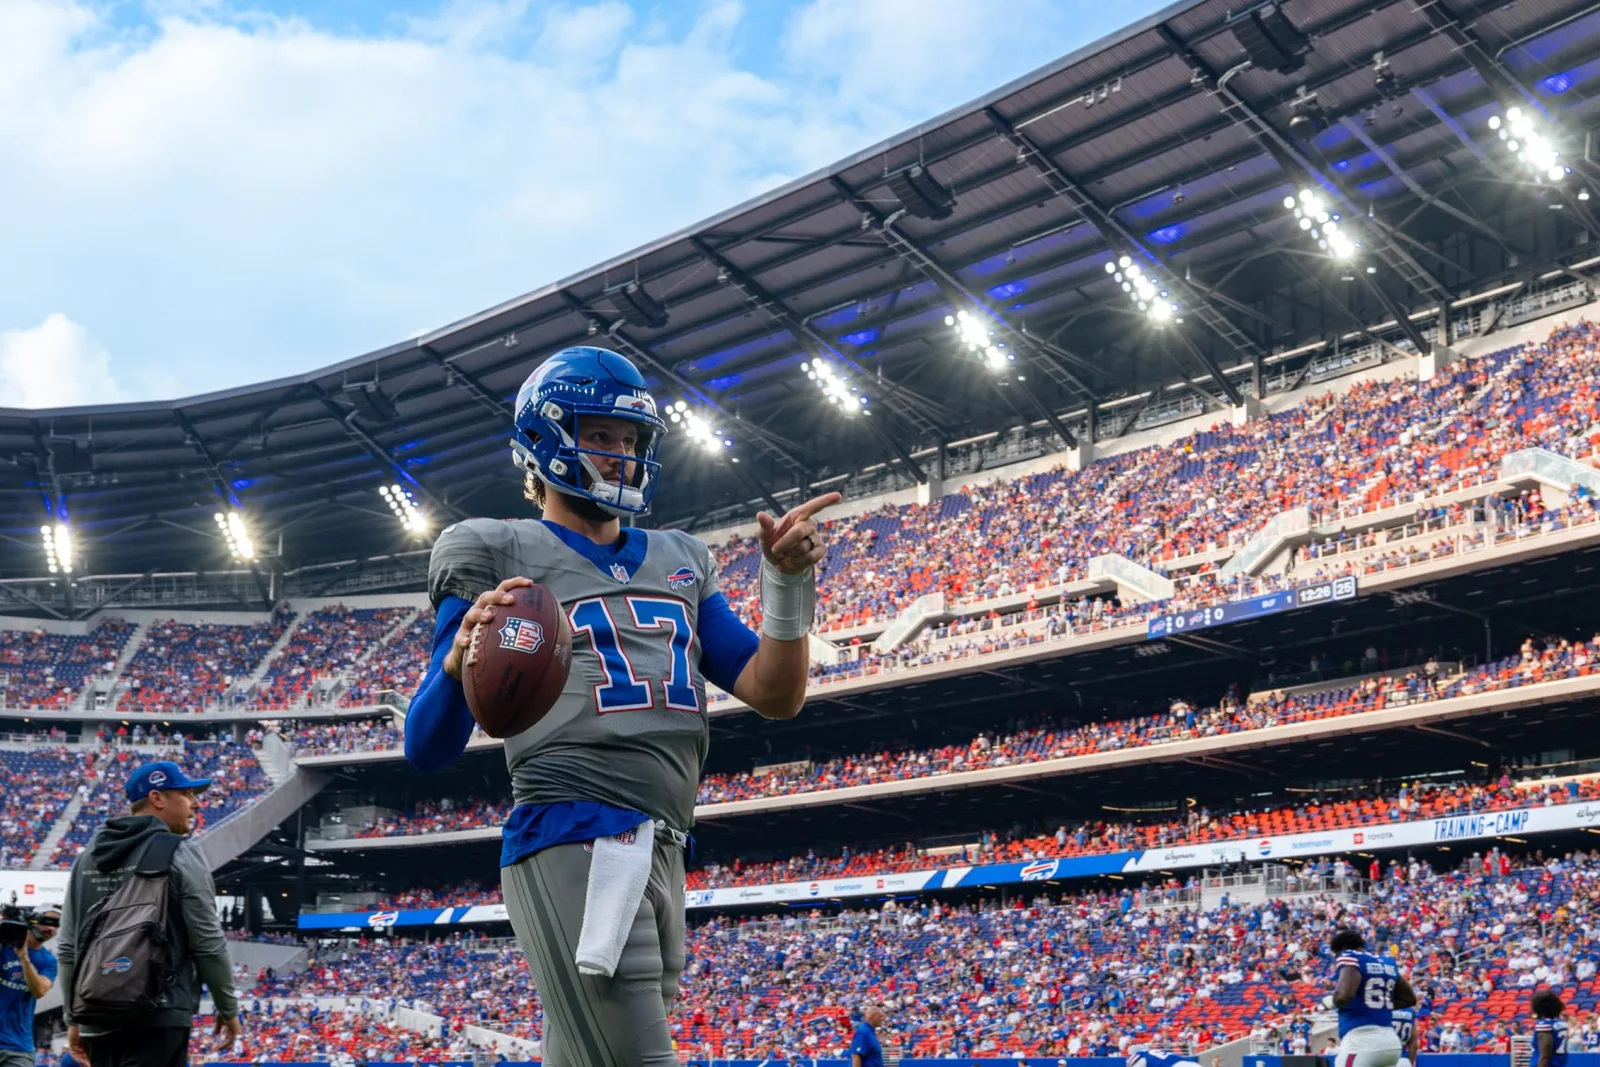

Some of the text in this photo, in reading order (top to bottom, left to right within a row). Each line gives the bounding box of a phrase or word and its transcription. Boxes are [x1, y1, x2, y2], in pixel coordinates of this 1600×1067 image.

[1336, 582, 1352, 596] 25
[1175, 616, 1185, 628] 0
[1213, 608, 1225, 621] 0
[516, 624, 539, 650] NFL
[567, 596, 699, 712] 17
[1434, 816, 1485, 840] TRAINING
[1495, 811, 1529, 833] CAMP
